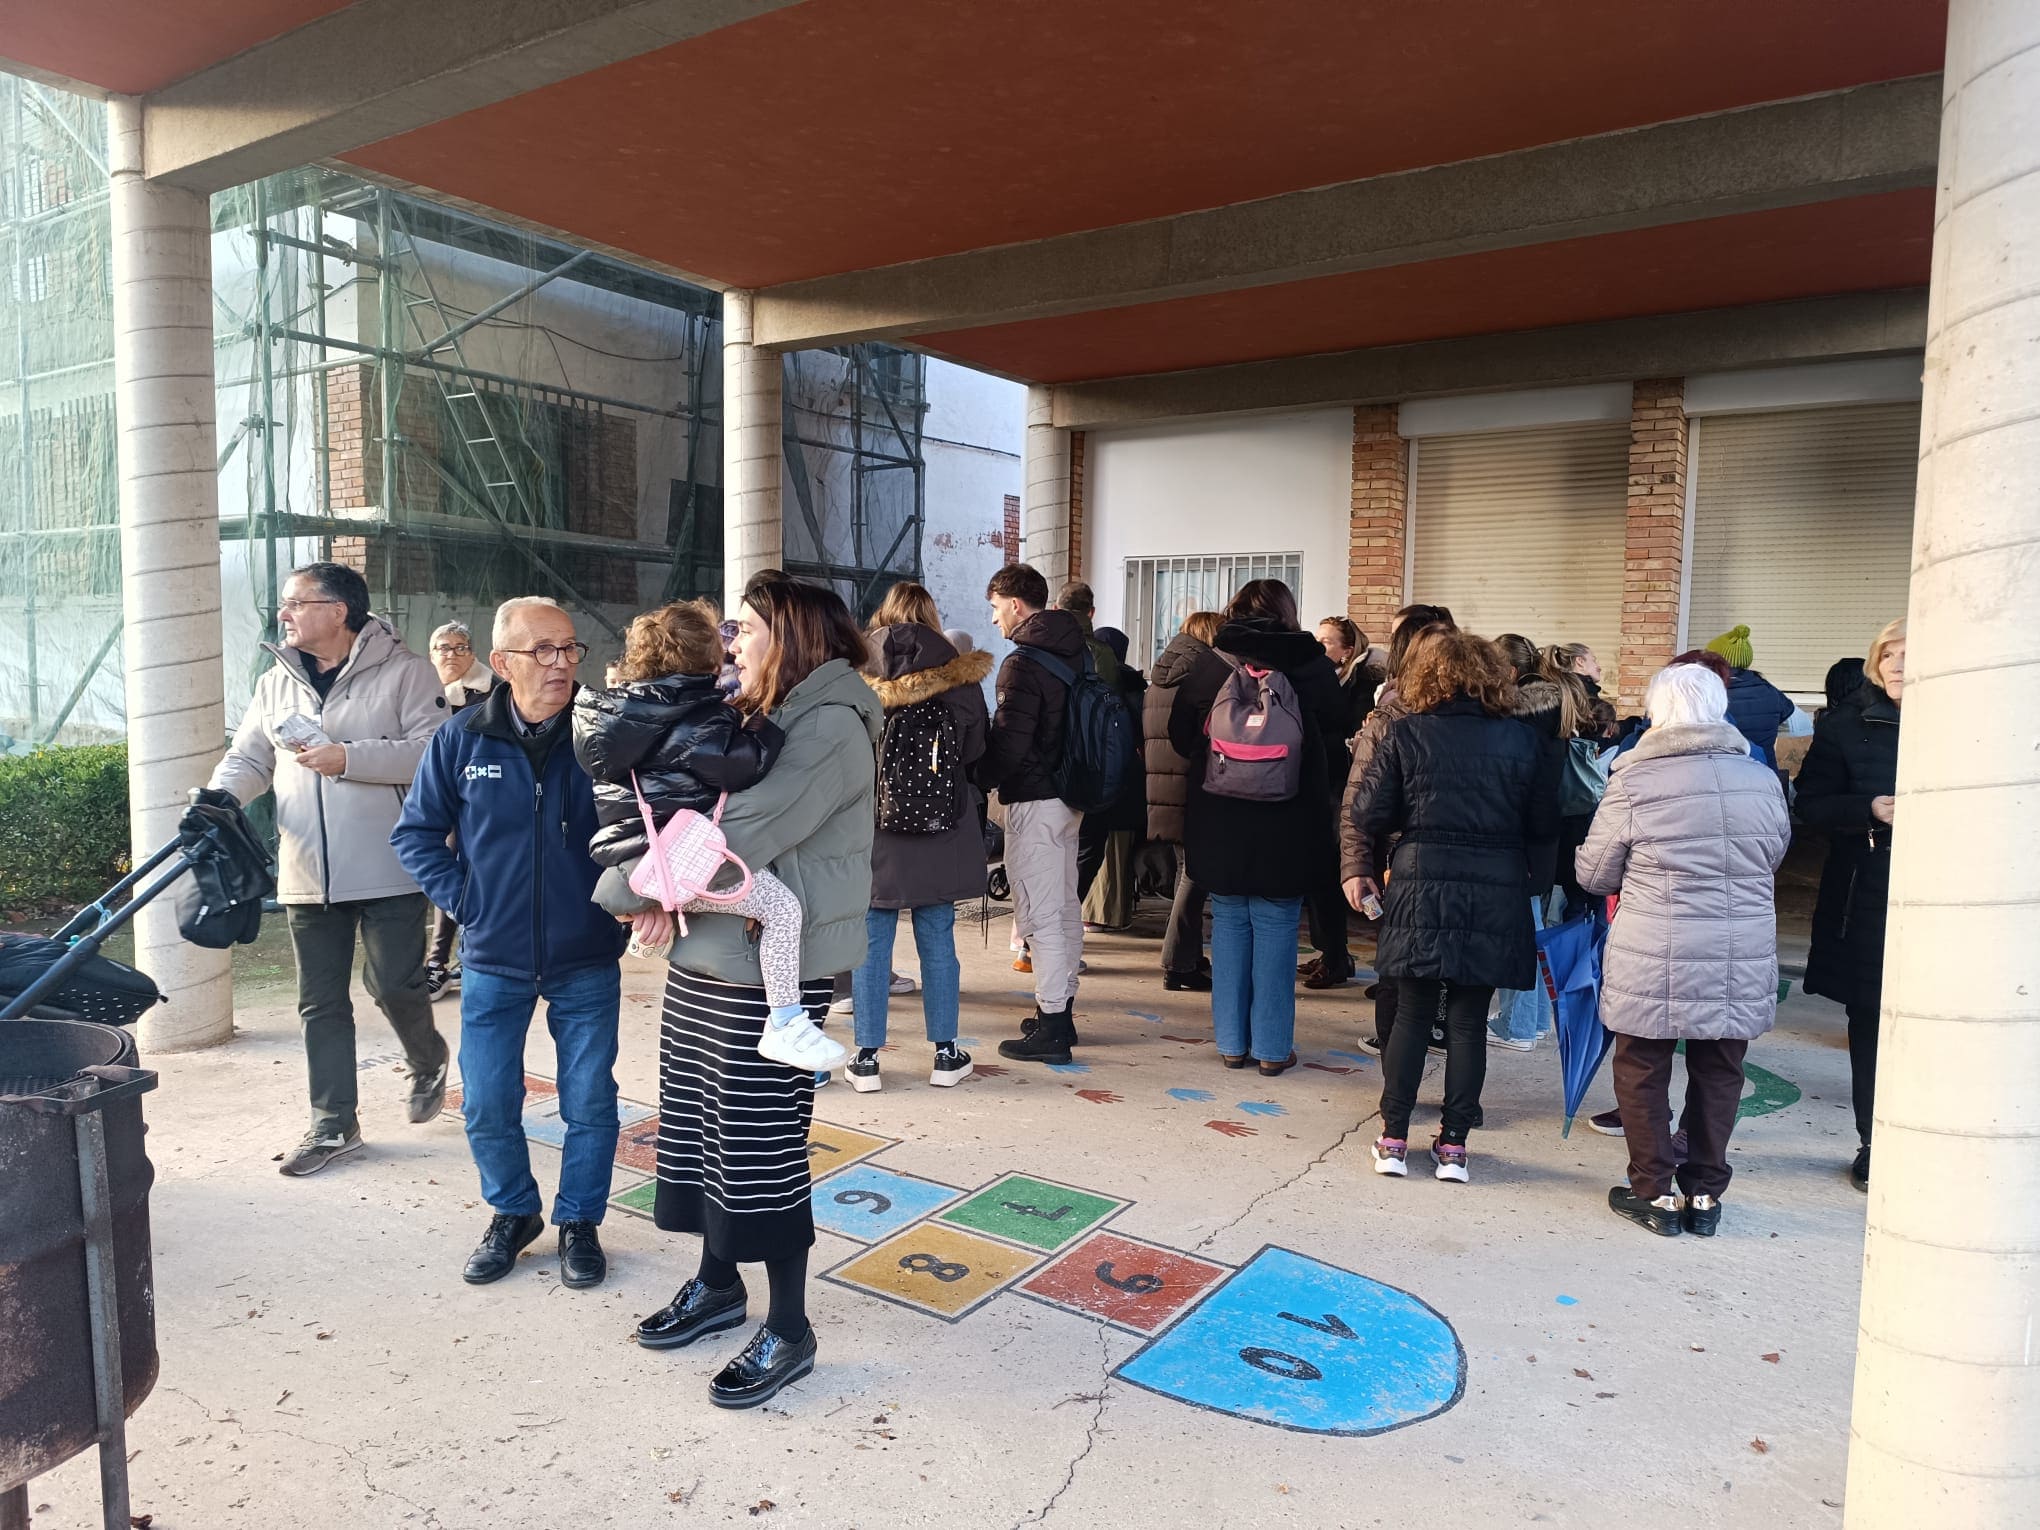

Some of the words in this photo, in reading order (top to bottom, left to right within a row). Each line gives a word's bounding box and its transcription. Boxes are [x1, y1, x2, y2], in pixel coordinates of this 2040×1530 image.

[834, 1190, 891, 1214] 6
[1000, 1201, 1073, 1221] 7
[898, 1253, 970, 1283] 8
[1095, 1260, 1164, 1294] 9
[1238, 1311, 1360, 1380] 10
